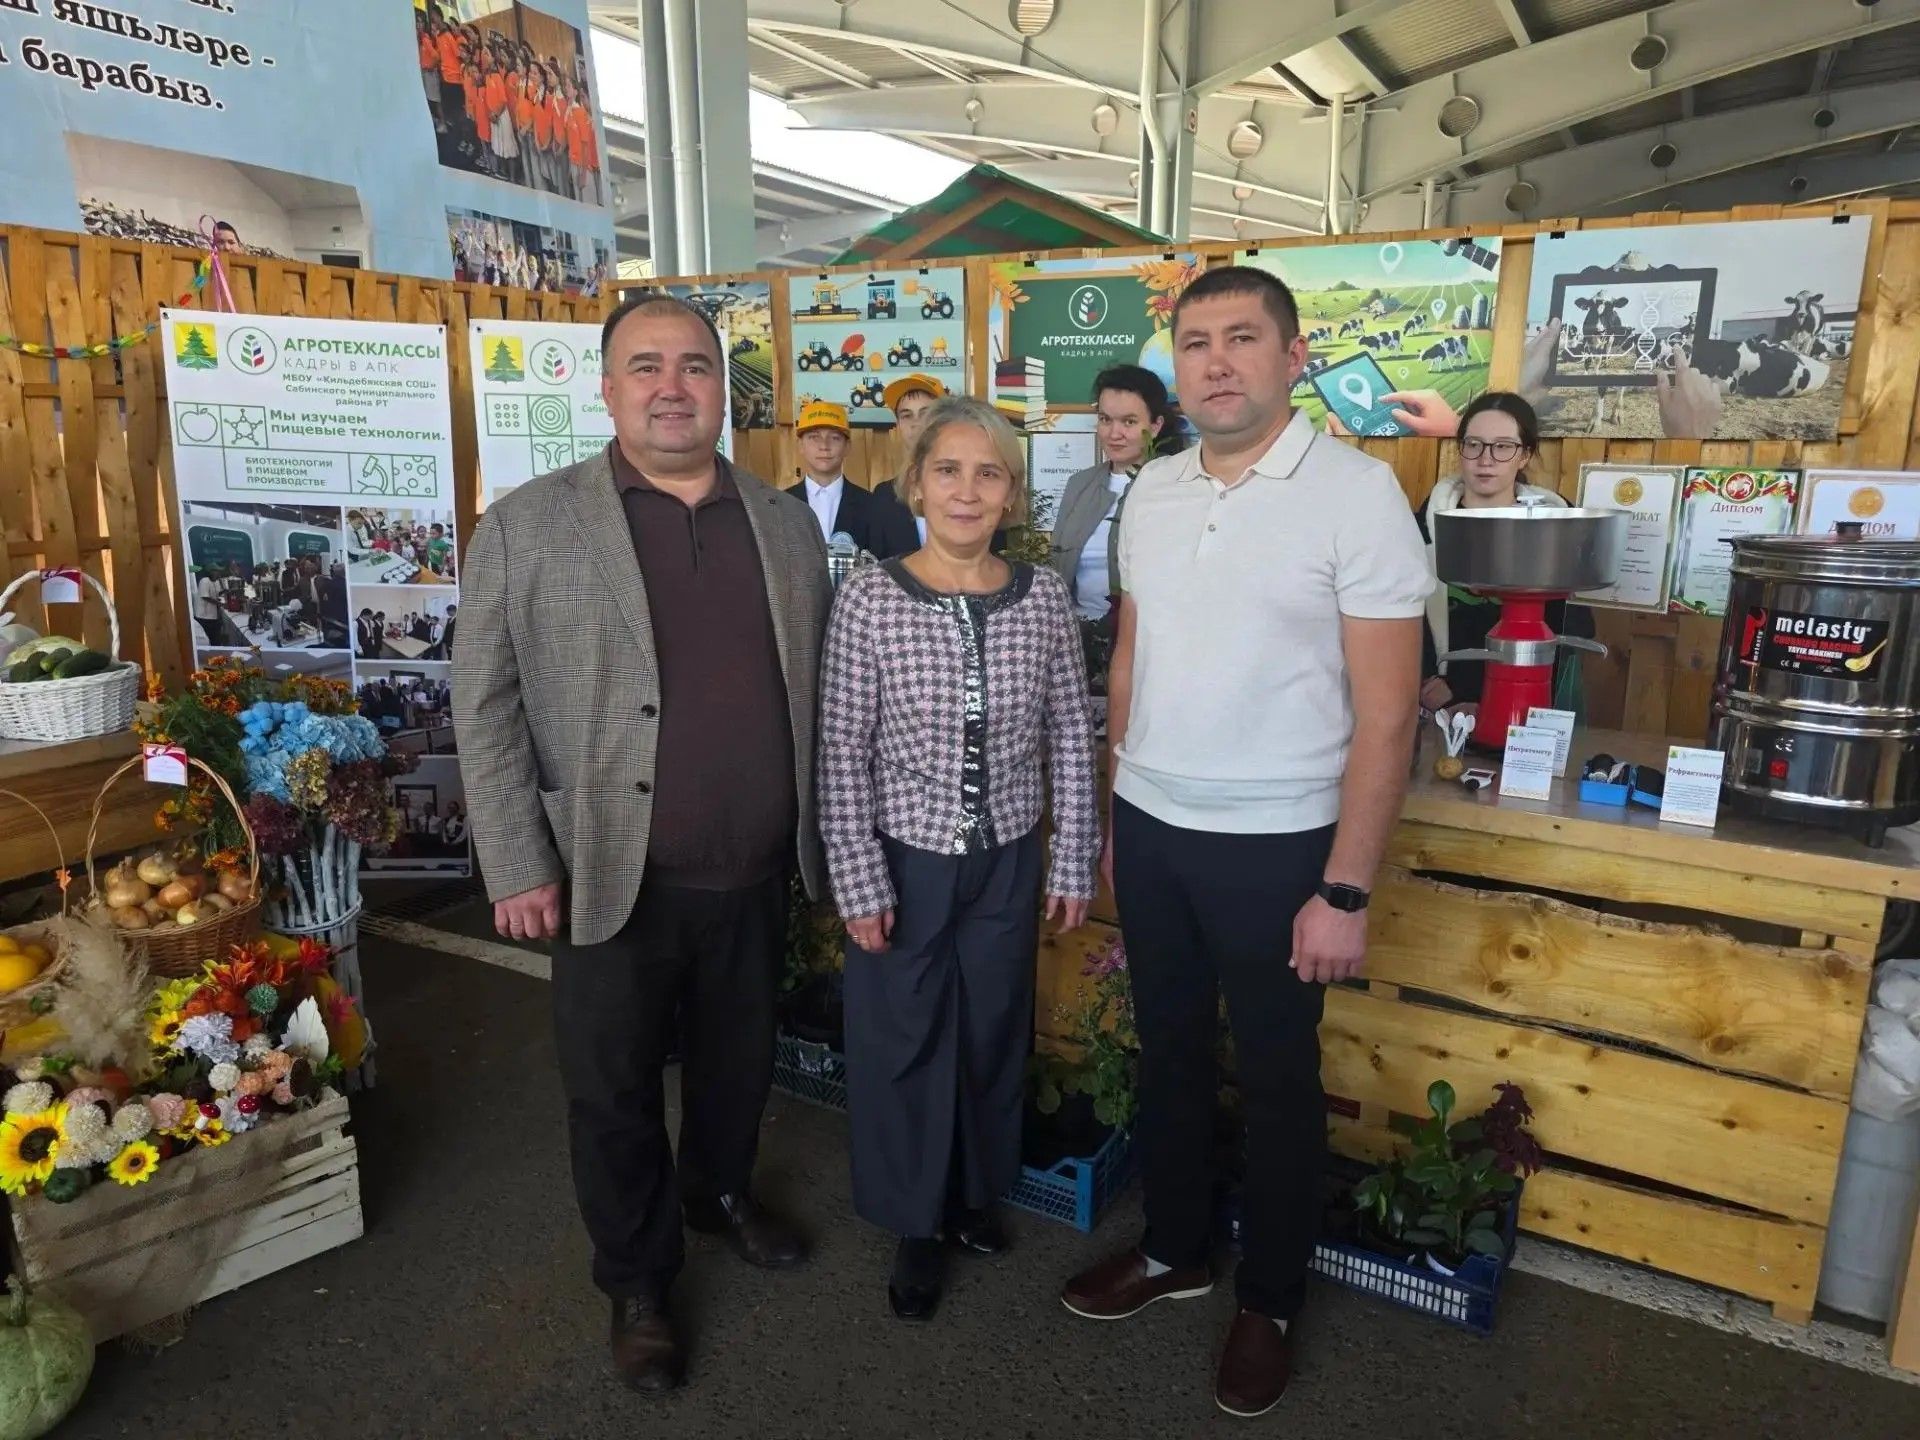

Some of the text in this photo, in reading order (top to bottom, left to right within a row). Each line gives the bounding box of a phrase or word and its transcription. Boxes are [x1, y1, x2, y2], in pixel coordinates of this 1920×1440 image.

[54, 0, 250, 67] яшьләре
[22, 38, 224, 109] барабыз.
[284, 337, 441, 359] АГРОТЕХКЛАССЫ
[1041, 334, 1135, 347] АГРОТЕХКЛАССЫ
[1060, 349, 1087, 358] КАДРЫ
[284, 357, 399, 373] КАДРЫ В АПК
[282, 373, 313, 383] МБОУ
[405, 380, 437, 389] СОШ»
[285, 384, 436, 400] Сабинского муниципального
[335, 398, 389, 409] района РТ
[270, 409, 368, 426] Мы изучаем
[270, 424, 446, 441] пищевые технологии.
[245, 456, 334, 468] БИОТЕХНОЛОГИИ
[246, 466, 308, 476] В ПИЩЕВОМ
[247, 476, 327, 487] ПРОИЗВОДСТВЕ
